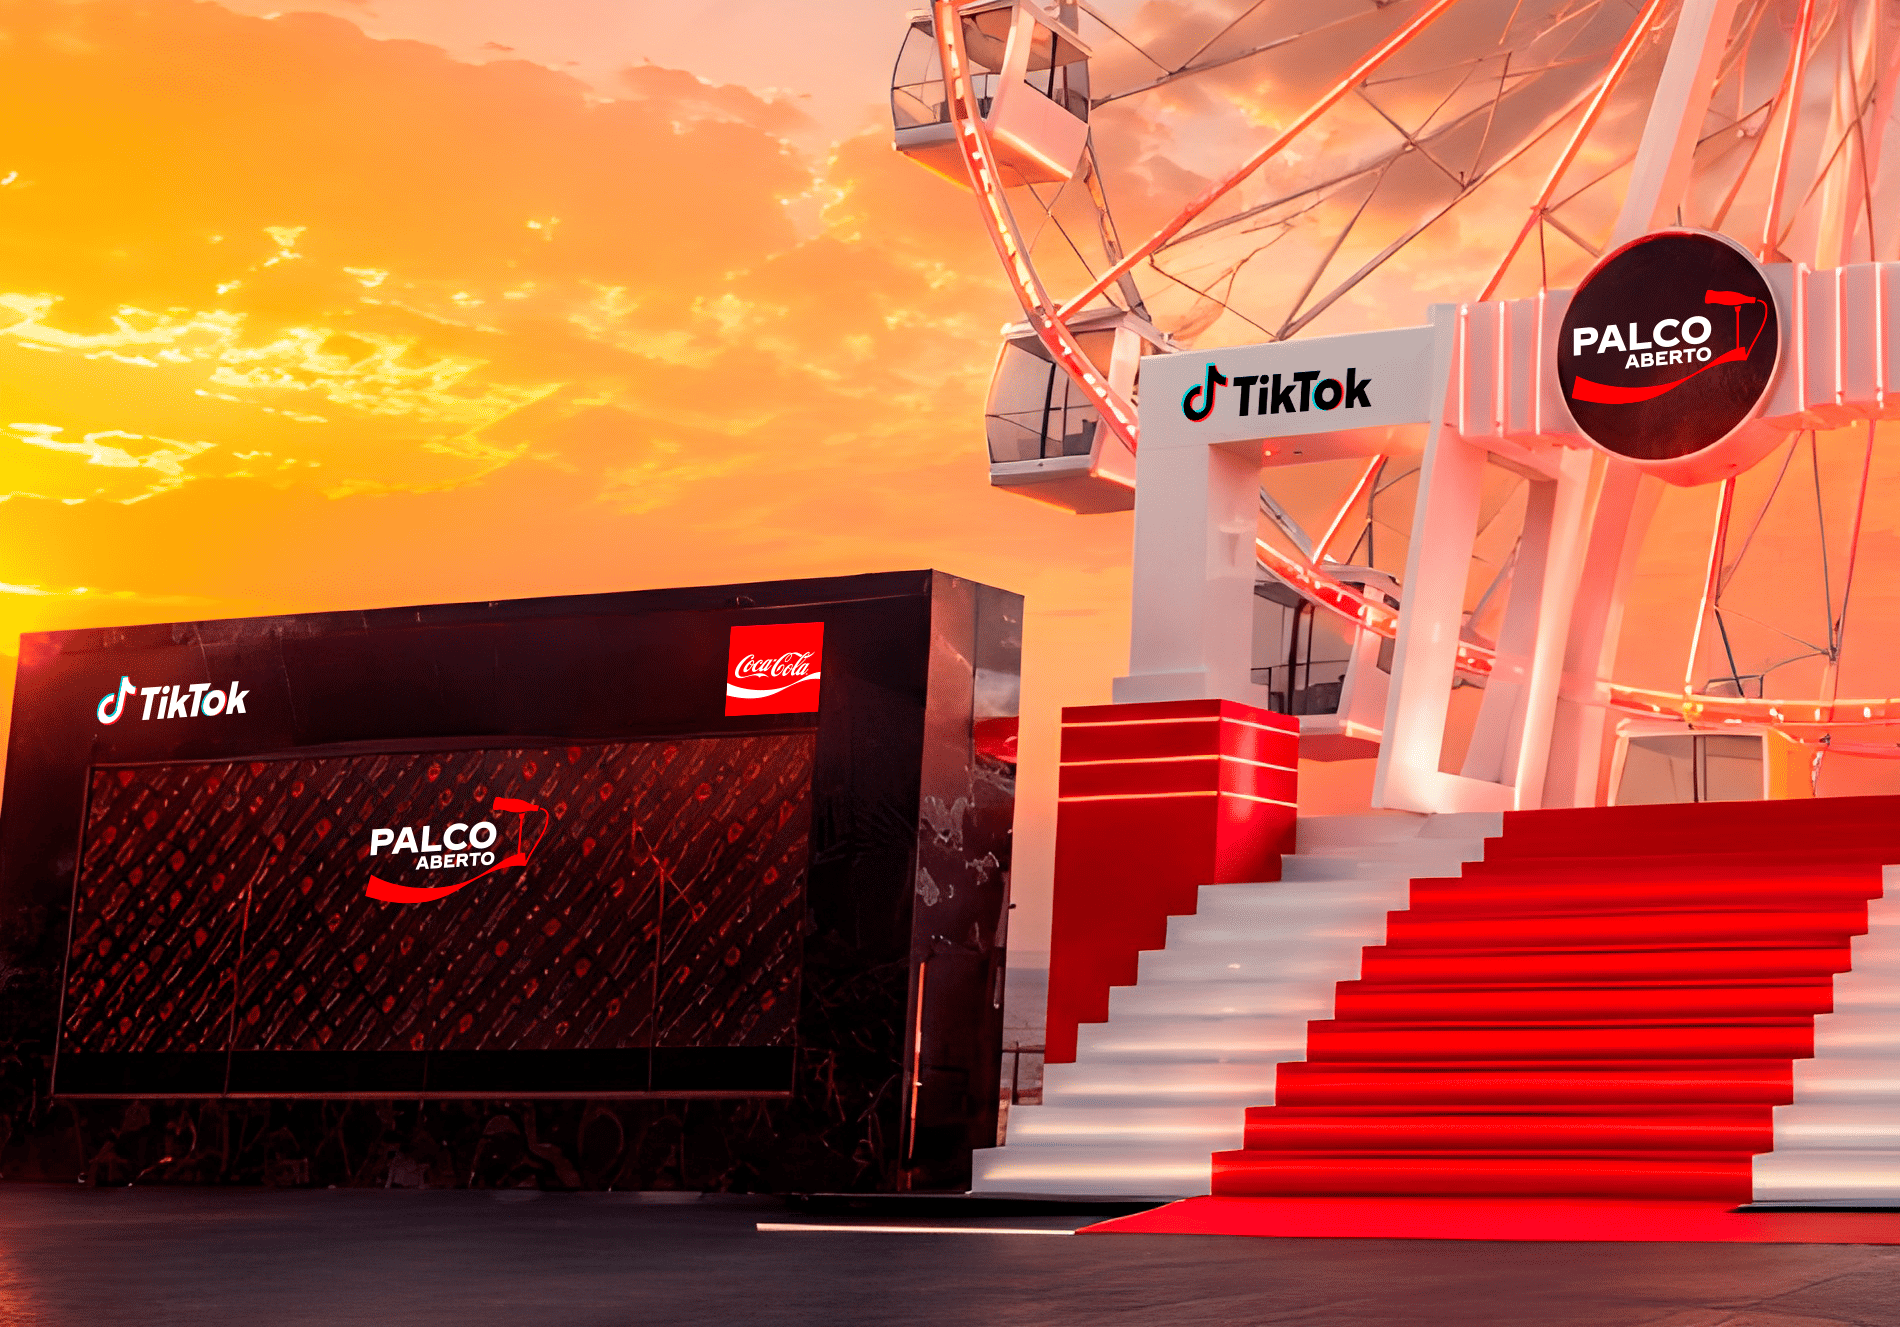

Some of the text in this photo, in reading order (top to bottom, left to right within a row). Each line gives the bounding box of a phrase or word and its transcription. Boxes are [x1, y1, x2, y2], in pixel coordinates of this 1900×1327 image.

[1572, 315, 1712, 358] PALCO
[1624, 346, 1712, 370] ABERTO
[1231, 367, 1373, 418] TikTok
[734, 650, 815, 679] Coca-Cola
[140, 680, 250, 721] TikTok
[369, 821, 497, 856] PALCO
[415, 851, 496, 871] ABERTO
